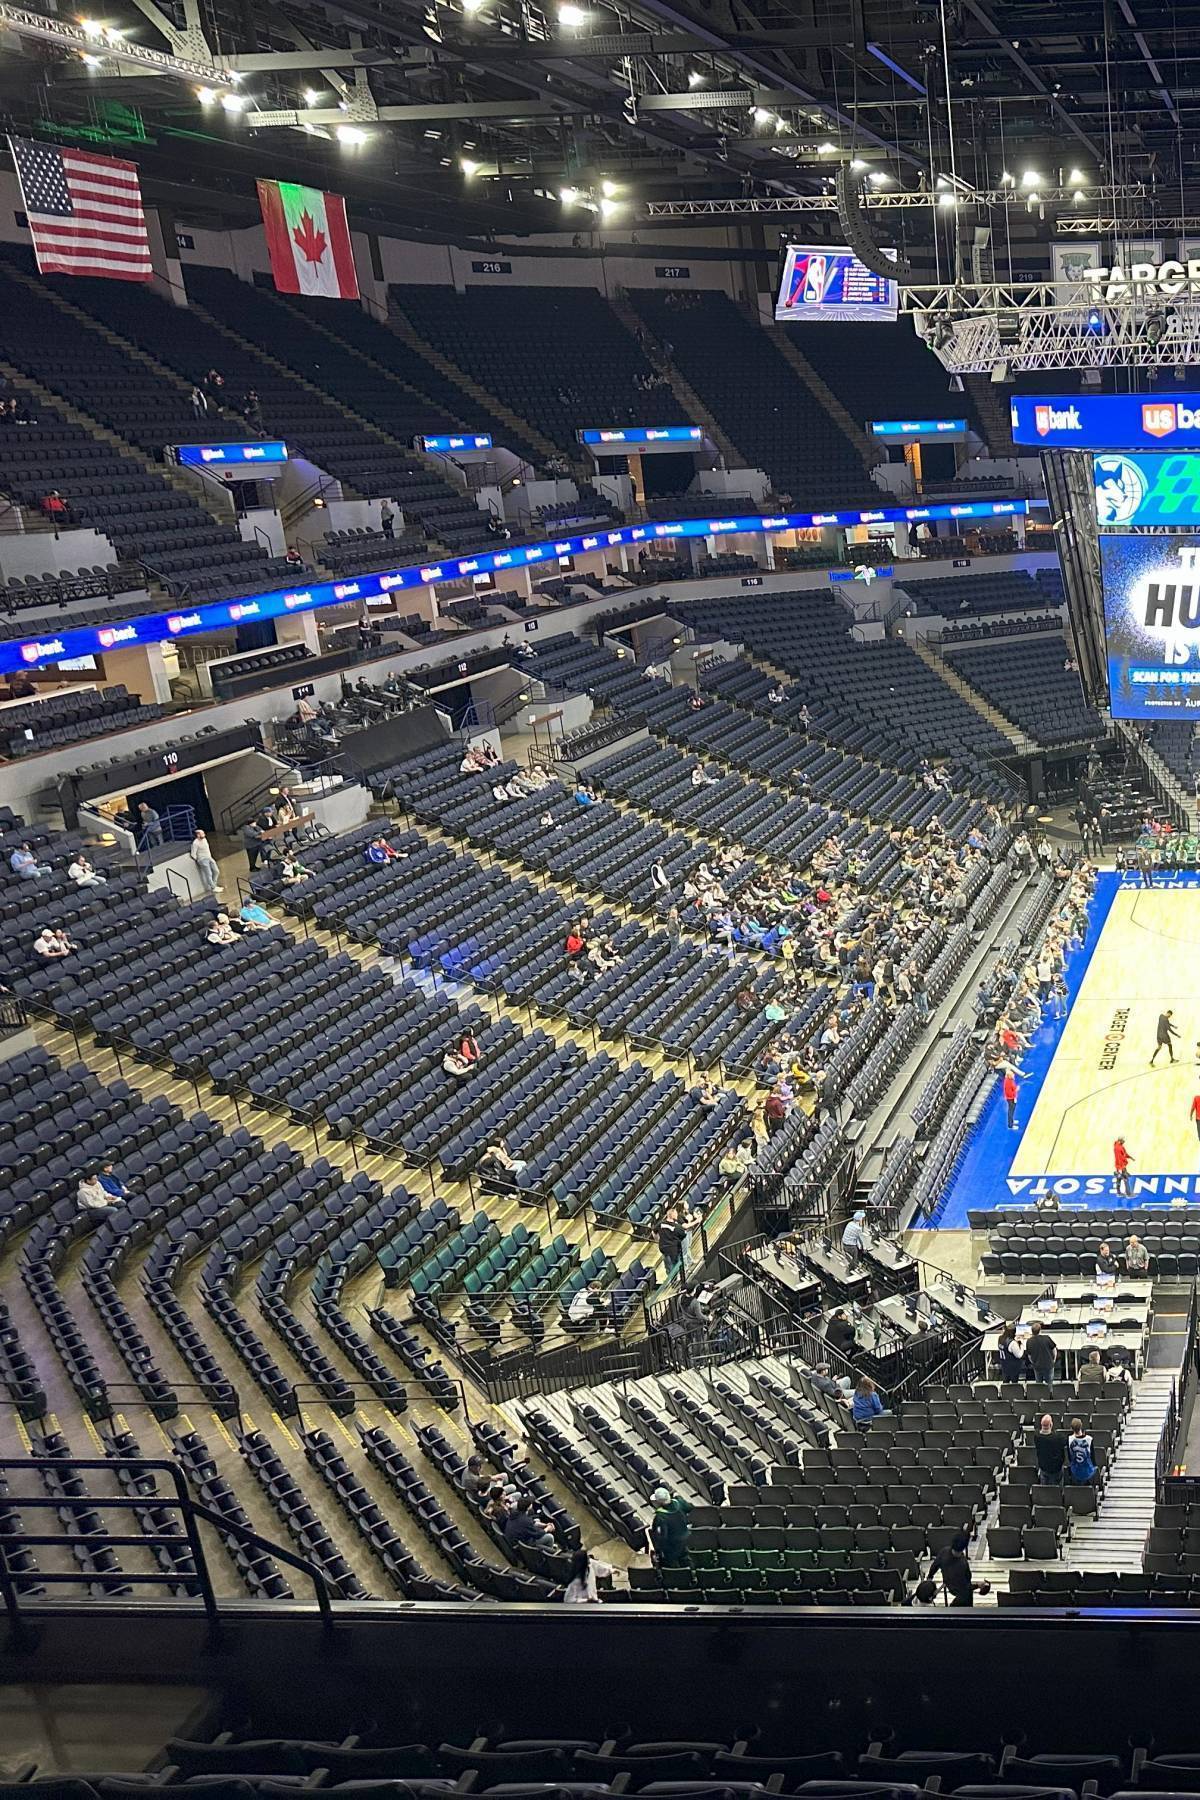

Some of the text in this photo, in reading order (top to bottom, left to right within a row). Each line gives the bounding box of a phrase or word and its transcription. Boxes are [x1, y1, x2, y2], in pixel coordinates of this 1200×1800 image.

[483, 262, 501, 272] 216
[664, 268, 680, 277] 217
[1018, 273, 1033, 282] 219
[1164, 640, 1190, 664] IS
[1133, 671, 1159, 683] SCAN
[1160, 671, 1179, 683] FOR
[163, 752, 178, 765] 110
[1098, 1008, 1131, 1071] TARGET CENTER
